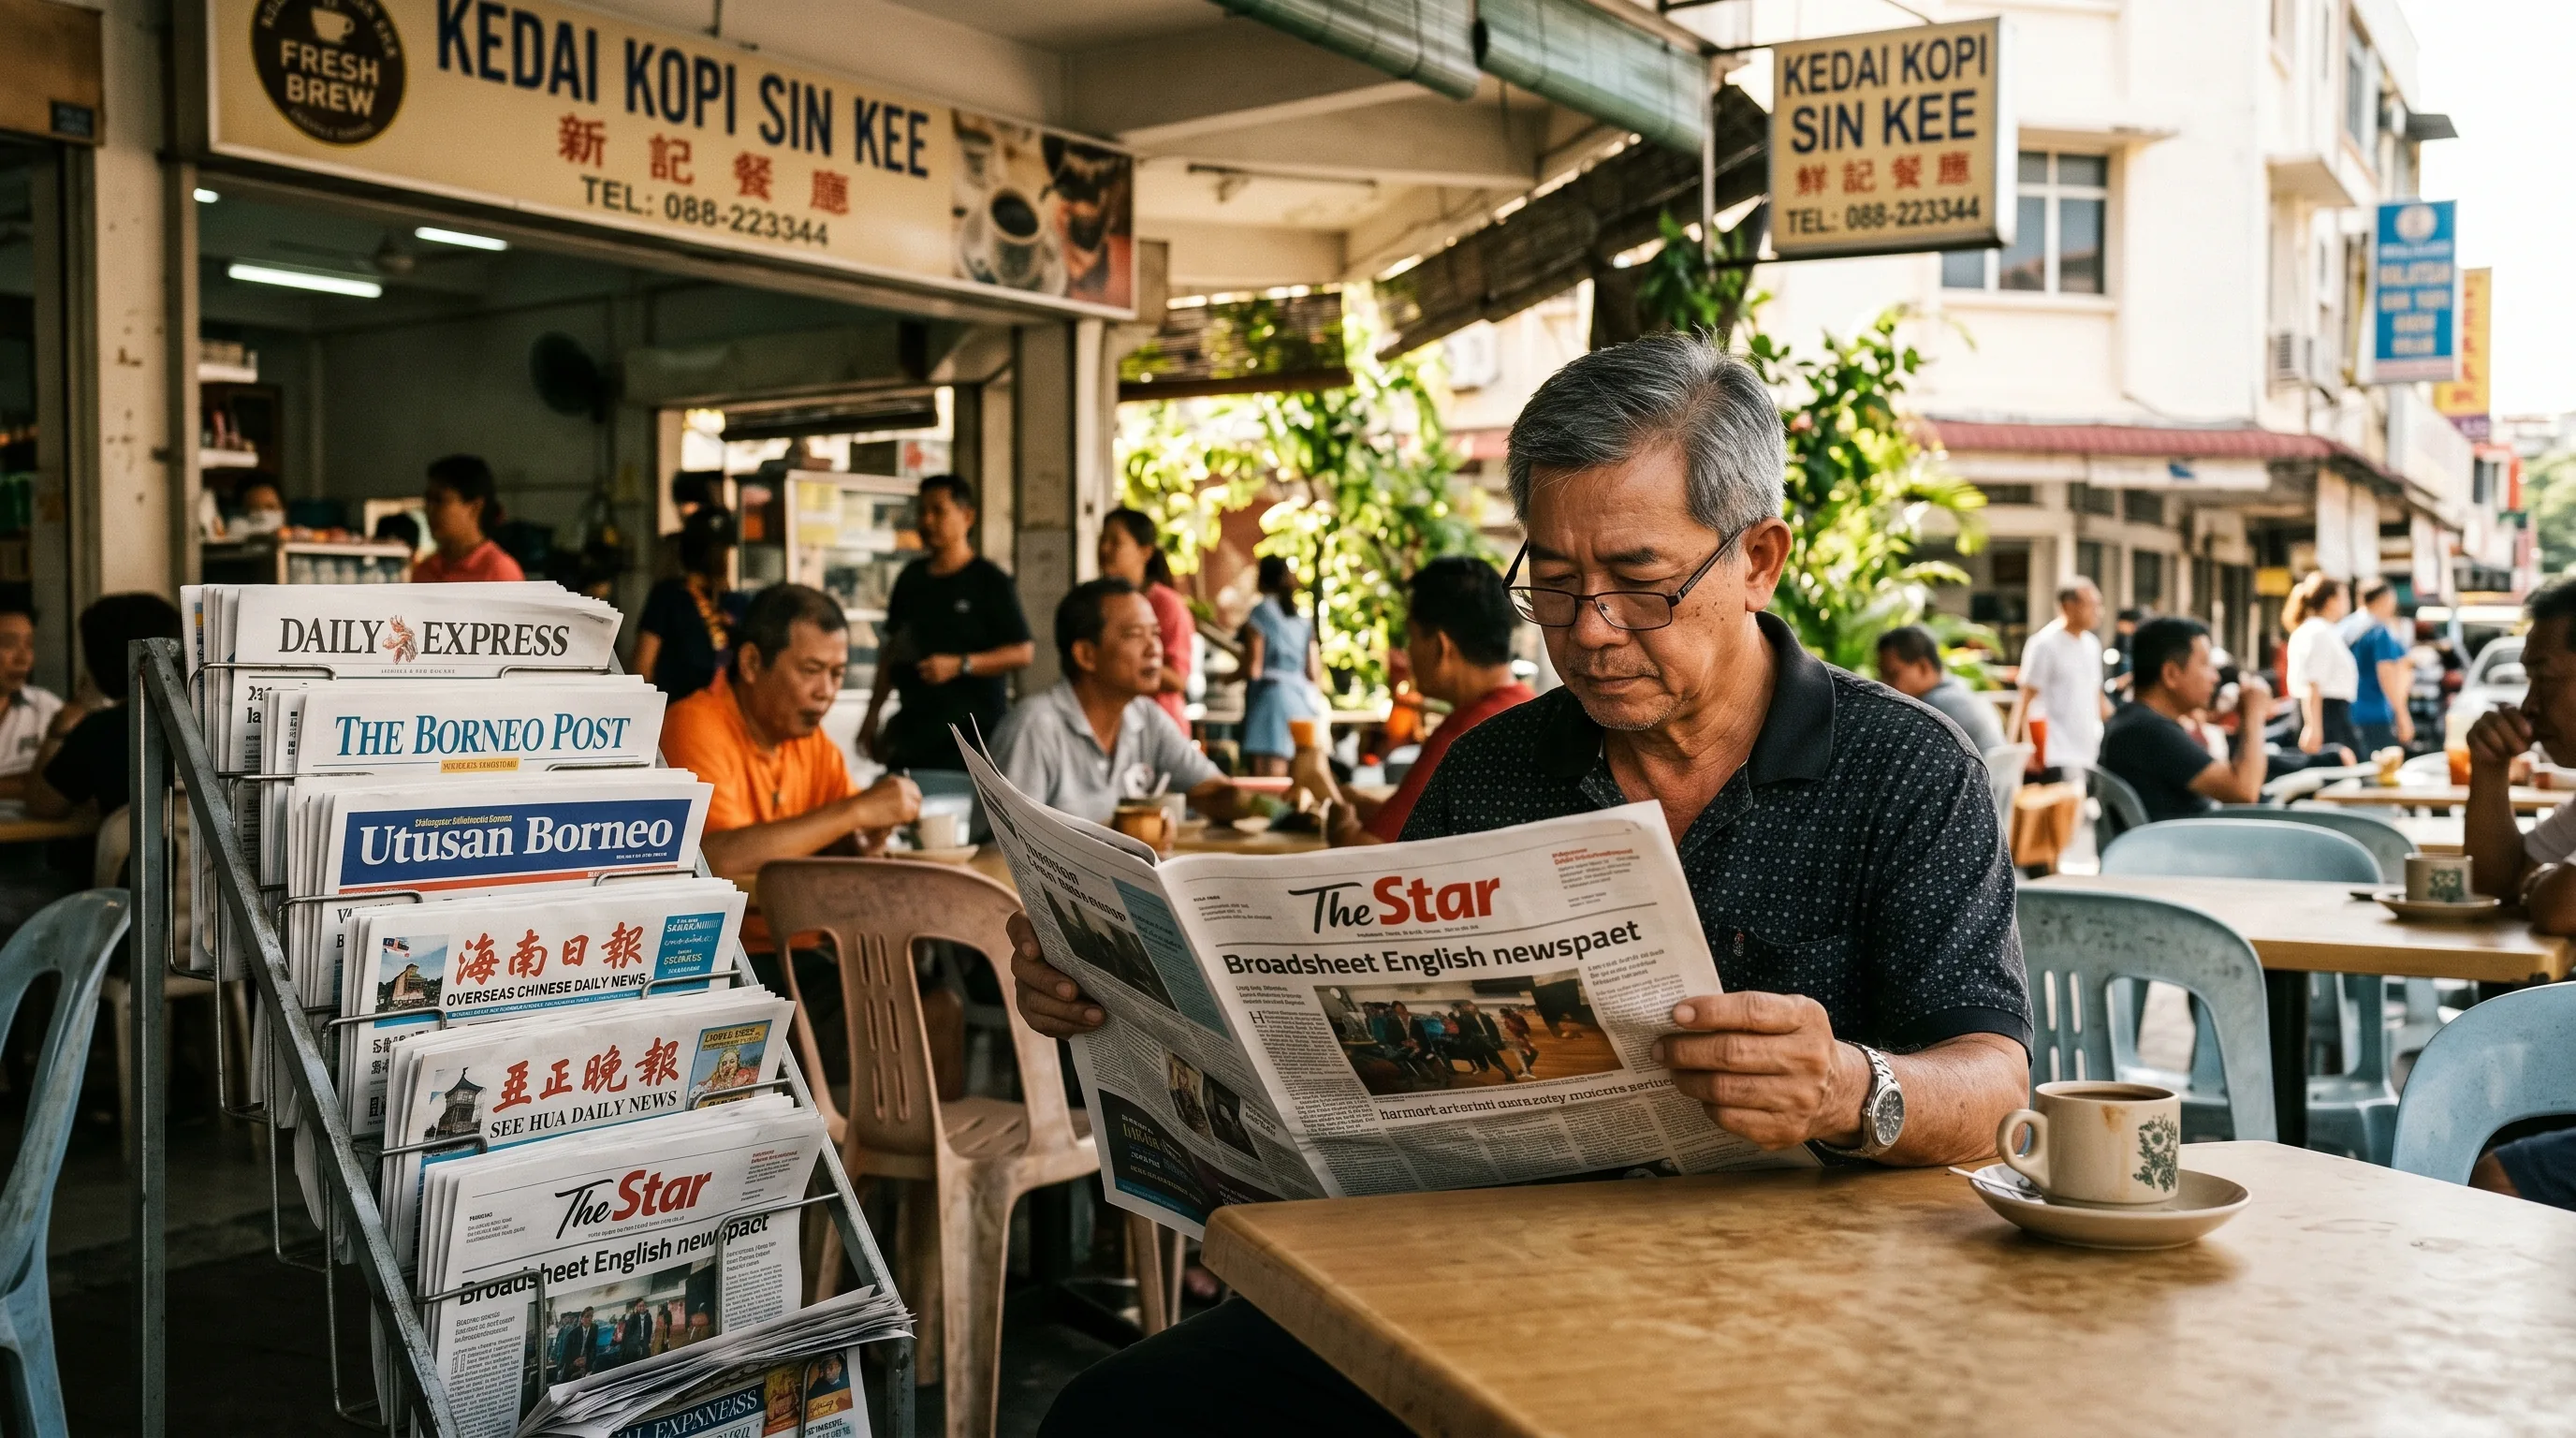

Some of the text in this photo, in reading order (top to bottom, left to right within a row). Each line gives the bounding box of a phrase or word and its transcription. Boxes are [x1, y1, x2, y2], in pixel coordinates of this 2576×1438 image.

[281, 39, 380, 87] FRESH
[437, 0, 597, 104] KEDAI
[624, 37, 737, 137] KOPI
[758, 72, 833, 158] SIN
[854, 95, 929, 179] KEE
[1782, 32, 1987, 98] KEDAI KOPI
[285, 72, 376, 118] BREW
[1791, 89, 1977, 155] SIN KEE
[580, 174, 830, 248] TEL: 088-223344
[1844, 195, 1982, 231] 088-223344
[278, 618, 570, 657] DAILY EXPRESS
[335, 715, 405, 756] THE
[412, 714, 545, 756] BORNEO
[549, 712, 631, 750] POST
[359, 816, 674, 866] Utusan Borneo
[1287, 881, 1374, 934] The
[1372, 875, 1500, 926] Star
[1222, 952, 1381, 976] Broadsheet
[1382, 944, 1488, 977] English
[1492, 919, 1643, 966] newspaet
[446, 986, 515, 1006] OVERSEAS
[517, 979, 573, 999] CHINESE
[574, 976, 609, 992] DAILY
[610, 972, 647, 989] NEWS
[490, 1090, 678, 1139] SEE HUA DAILY NEWS
[554, 1178, 614, 1240] The
[610, 1168, 713, 1222] Star
[593, 1237, 671, 1275] English
[676, 1213, 771, 1256] newpact
